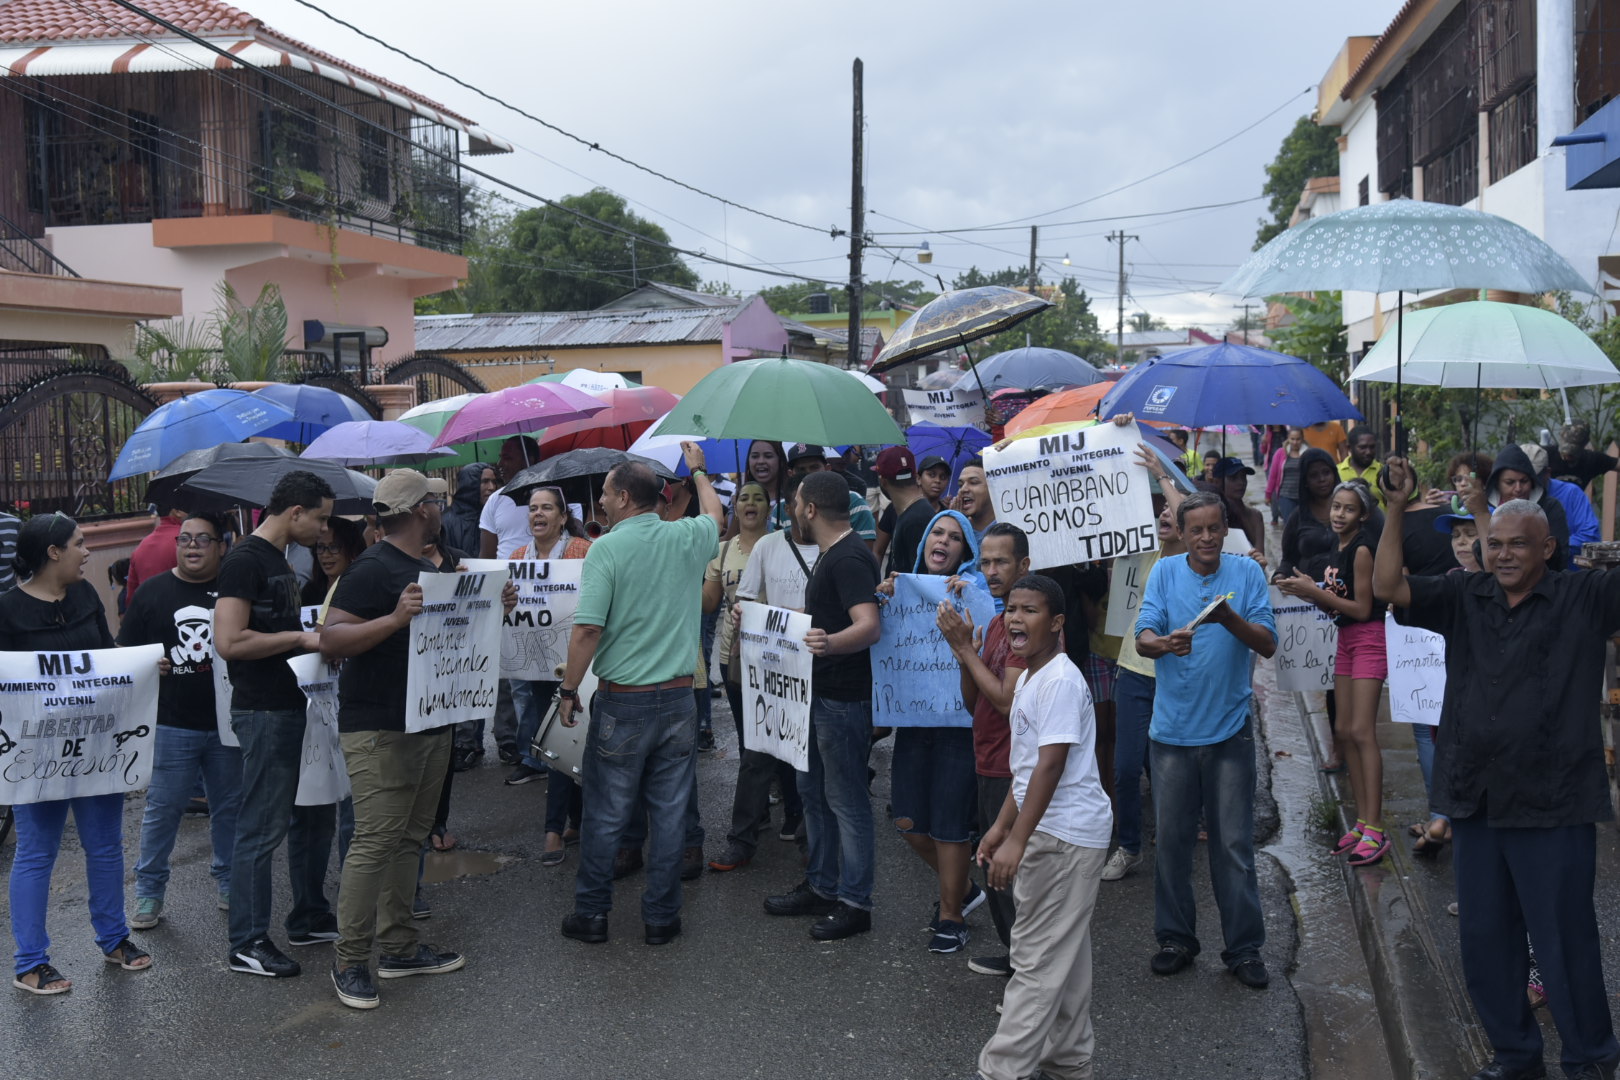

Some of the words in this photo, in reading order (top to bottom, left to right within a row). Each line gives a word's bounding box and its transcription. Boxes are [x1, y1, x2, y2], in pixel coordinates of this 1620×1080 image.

[927, 391, 954, 404] MIJ
[1039, 431, 1085, 456] MIJ
[986, 459, 1050, 479] MOVIMIENTO
[1072, 447, 1124, 463] INTEGRAL
[1050, 464, 1094, 478] JUVENIL
[1000, 471, 1129, 513] GUANABANO
[1023, 502, 1103, 535] SOMOS
[1078, 524, 1155, 559] TODOS
[508, 562, 550, 580] MIJ
[454, 574, 486, 596] MIJ
[534, 583, 577, 593] INTEGRAL
[466, 600, 491, 611] INTEGRAL
[518, 596, 547, 605] VENIL
[442, 616, 470, 627] JUVENIL
[765, 609, 790, 635] MIJ
[38, 652, 92, 676] MIJ
[172, 666, 195, 675] REAL
[0, 682, 56, 692] VIMIENTO
[72, 675, 133, 690] INTEGRAL
[748, 664, 760, 690] EL
[764, 669, 809, 706] HOSPITAL
[44, 696, 96, 707] JUVENIL
[21, 713, 116, 740] LIBERTAD
[61, 738, 86, 758] DE
